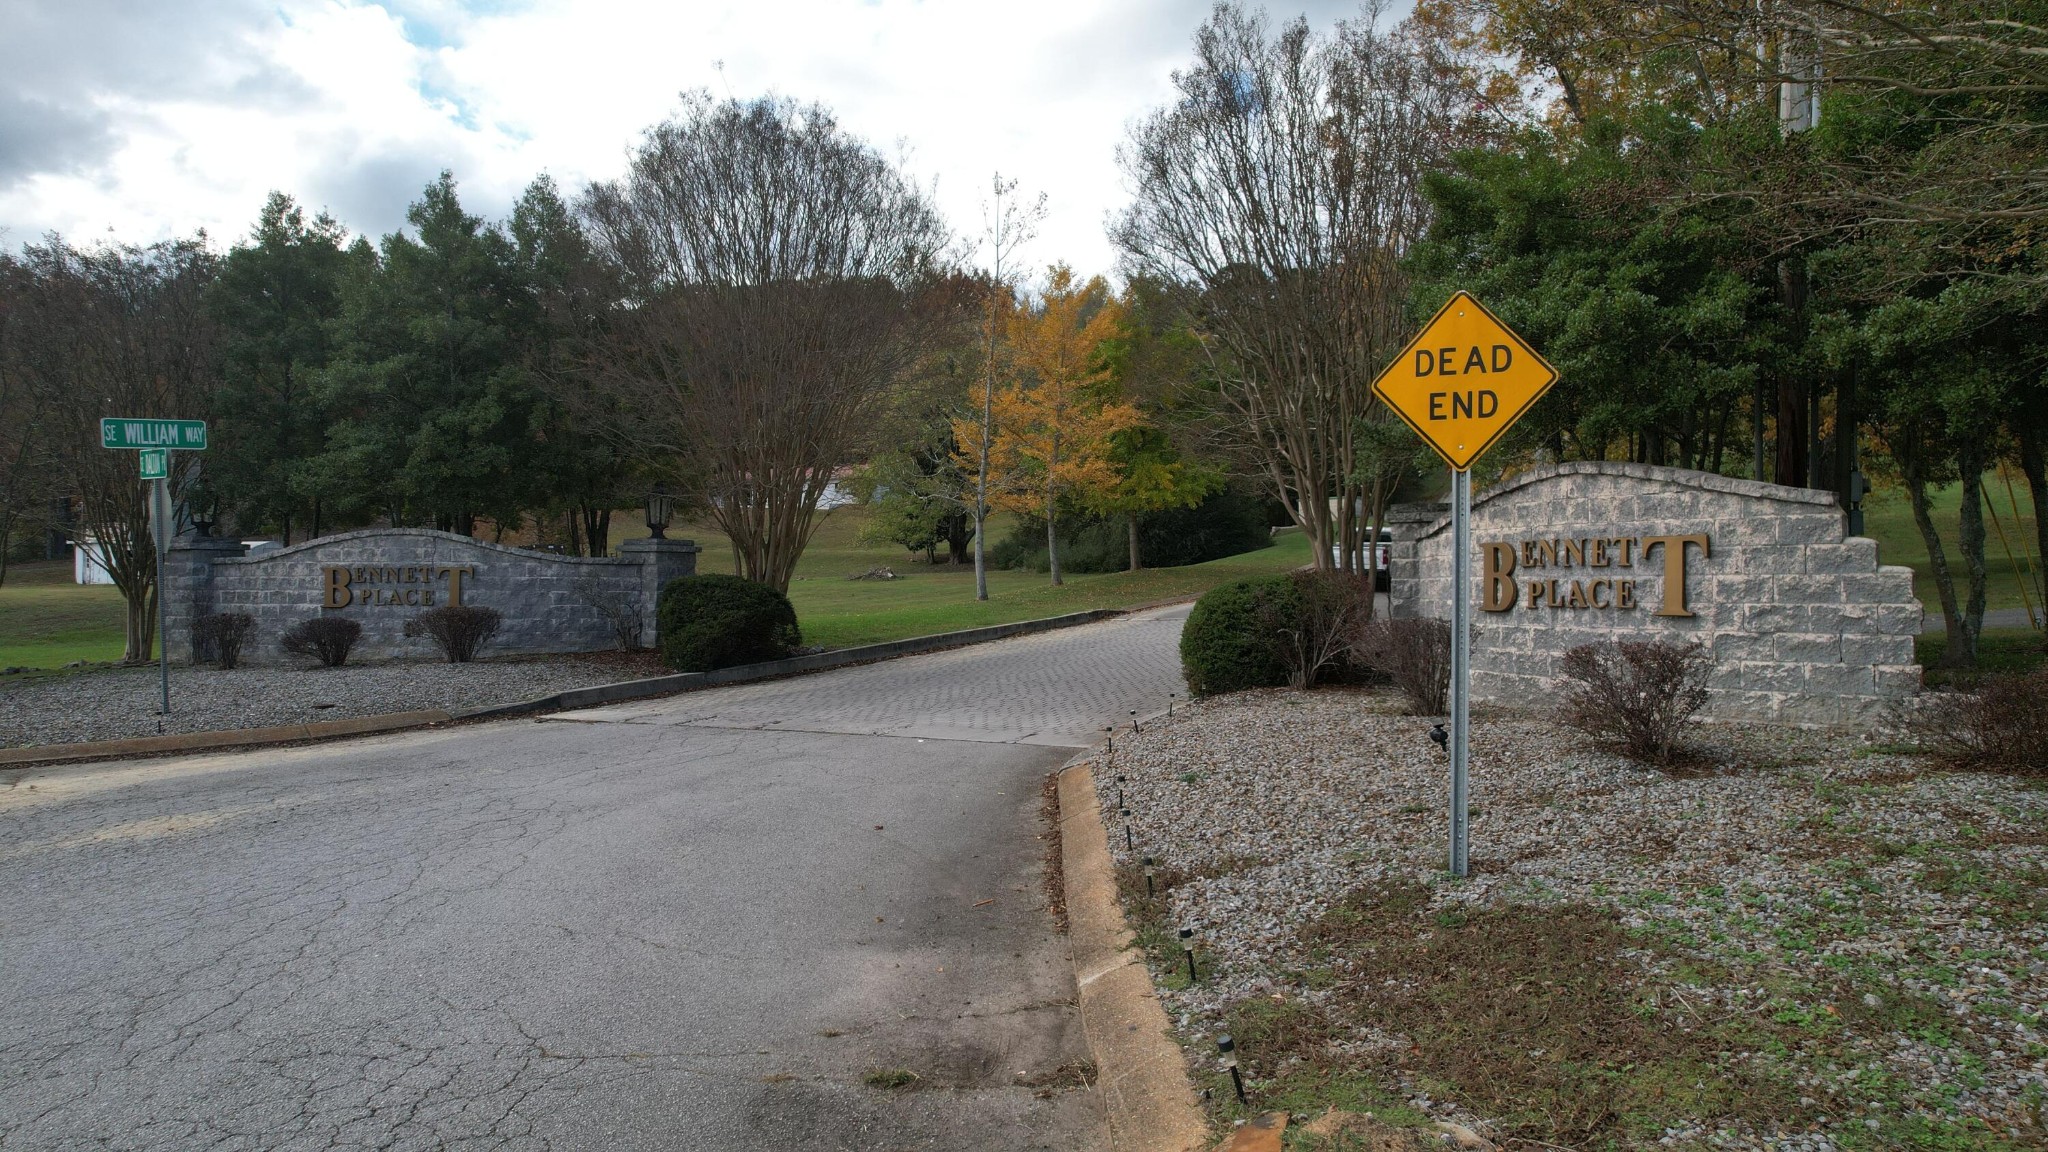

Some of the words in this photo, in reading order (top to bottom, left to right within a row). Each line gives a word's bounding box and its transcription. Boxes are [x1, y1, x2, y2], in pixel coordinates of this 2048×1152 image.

[1415, 345, 1512, 377] DEAD
[1429, 390, 1498, 420] END
[105, 425, 117, 441] SE
[124, 423, 179, 444] WILLIAM
[185, 427, 204, 442] WAY
[321, 566, 475, 608] BENNETT
[1478, 534, 1711, 618] BENNETT
[359, 589, 434, 606] PLACE
[1527, 578, 1636, 609] PLACE
